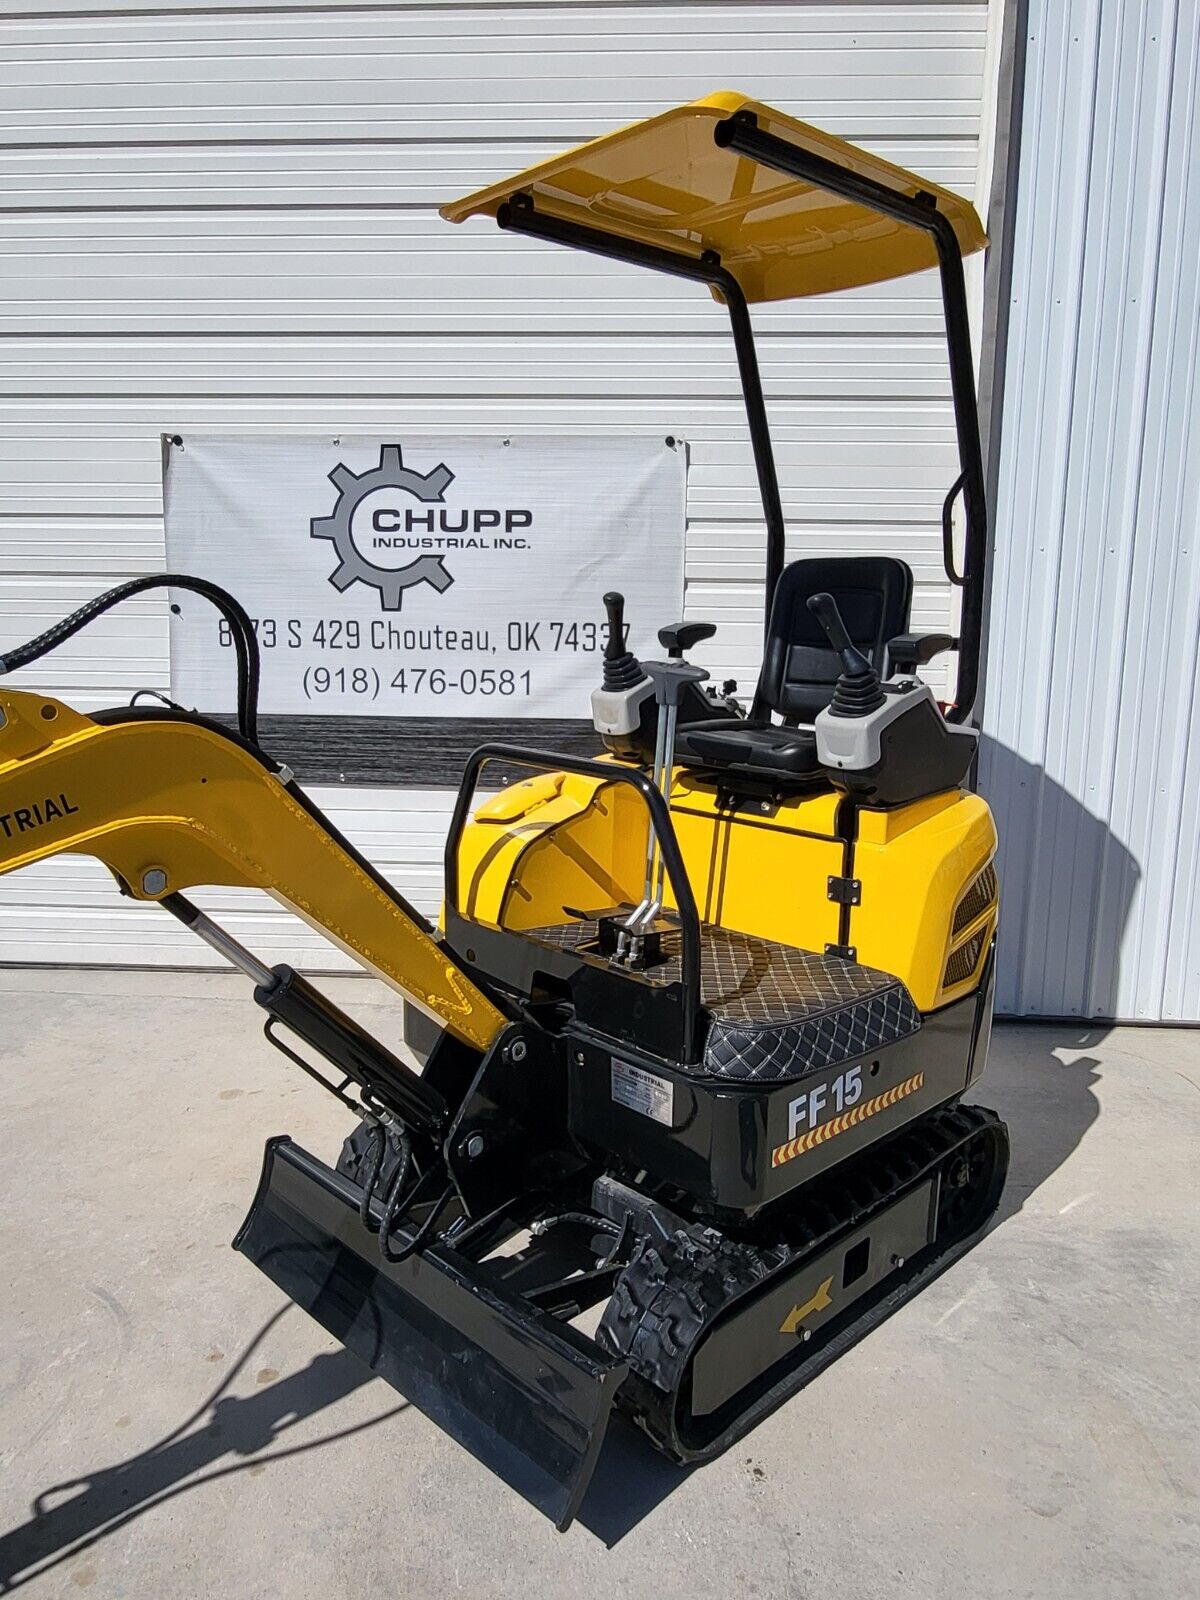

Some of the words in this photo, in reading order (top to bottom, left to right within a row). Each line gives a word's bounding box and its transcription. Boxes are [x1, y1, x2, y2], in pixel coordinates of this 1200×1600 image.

[372, 508, 533, 533] CHUPP
[372, 537, 490, 549] INDUSTRIAL
[494, 538, 532, 549] INC.
[287, 619, 302, 649] S
[312, 620, 361, 650] 429
[370, 621, 497, 655] Chouteau,
[507, 622, 541, 651] OK
[302, 667, 380, 699] (918)
[390, 669, 532, 696] 476-0581
